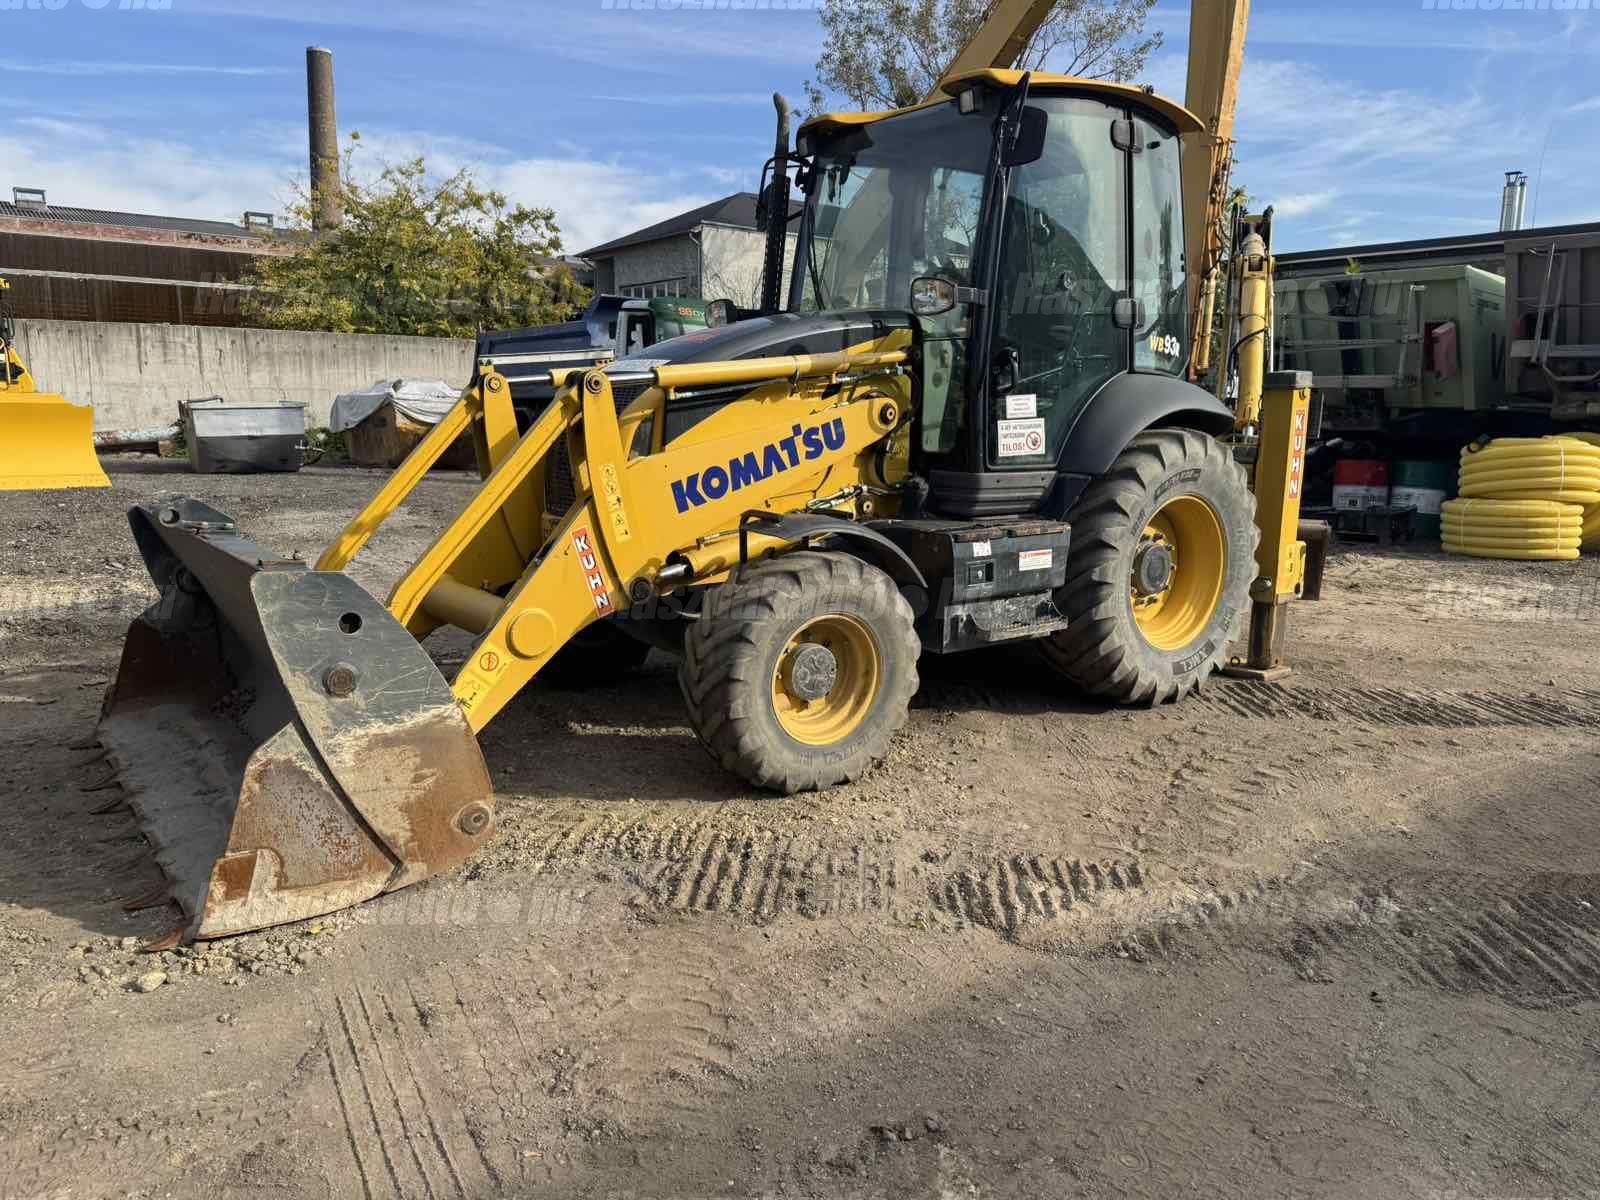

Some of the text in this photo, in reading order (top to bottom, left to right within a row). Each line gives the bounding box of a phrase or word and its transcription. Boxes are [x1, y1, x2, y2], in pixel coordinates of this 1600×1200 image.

[671, 417, 846, 514] KOMATSU
[1002, 442, 1026, 452] TILOS!
[1289, 414, 1304, 494] KUHN
[575, 535, 609, 609] KUHN
